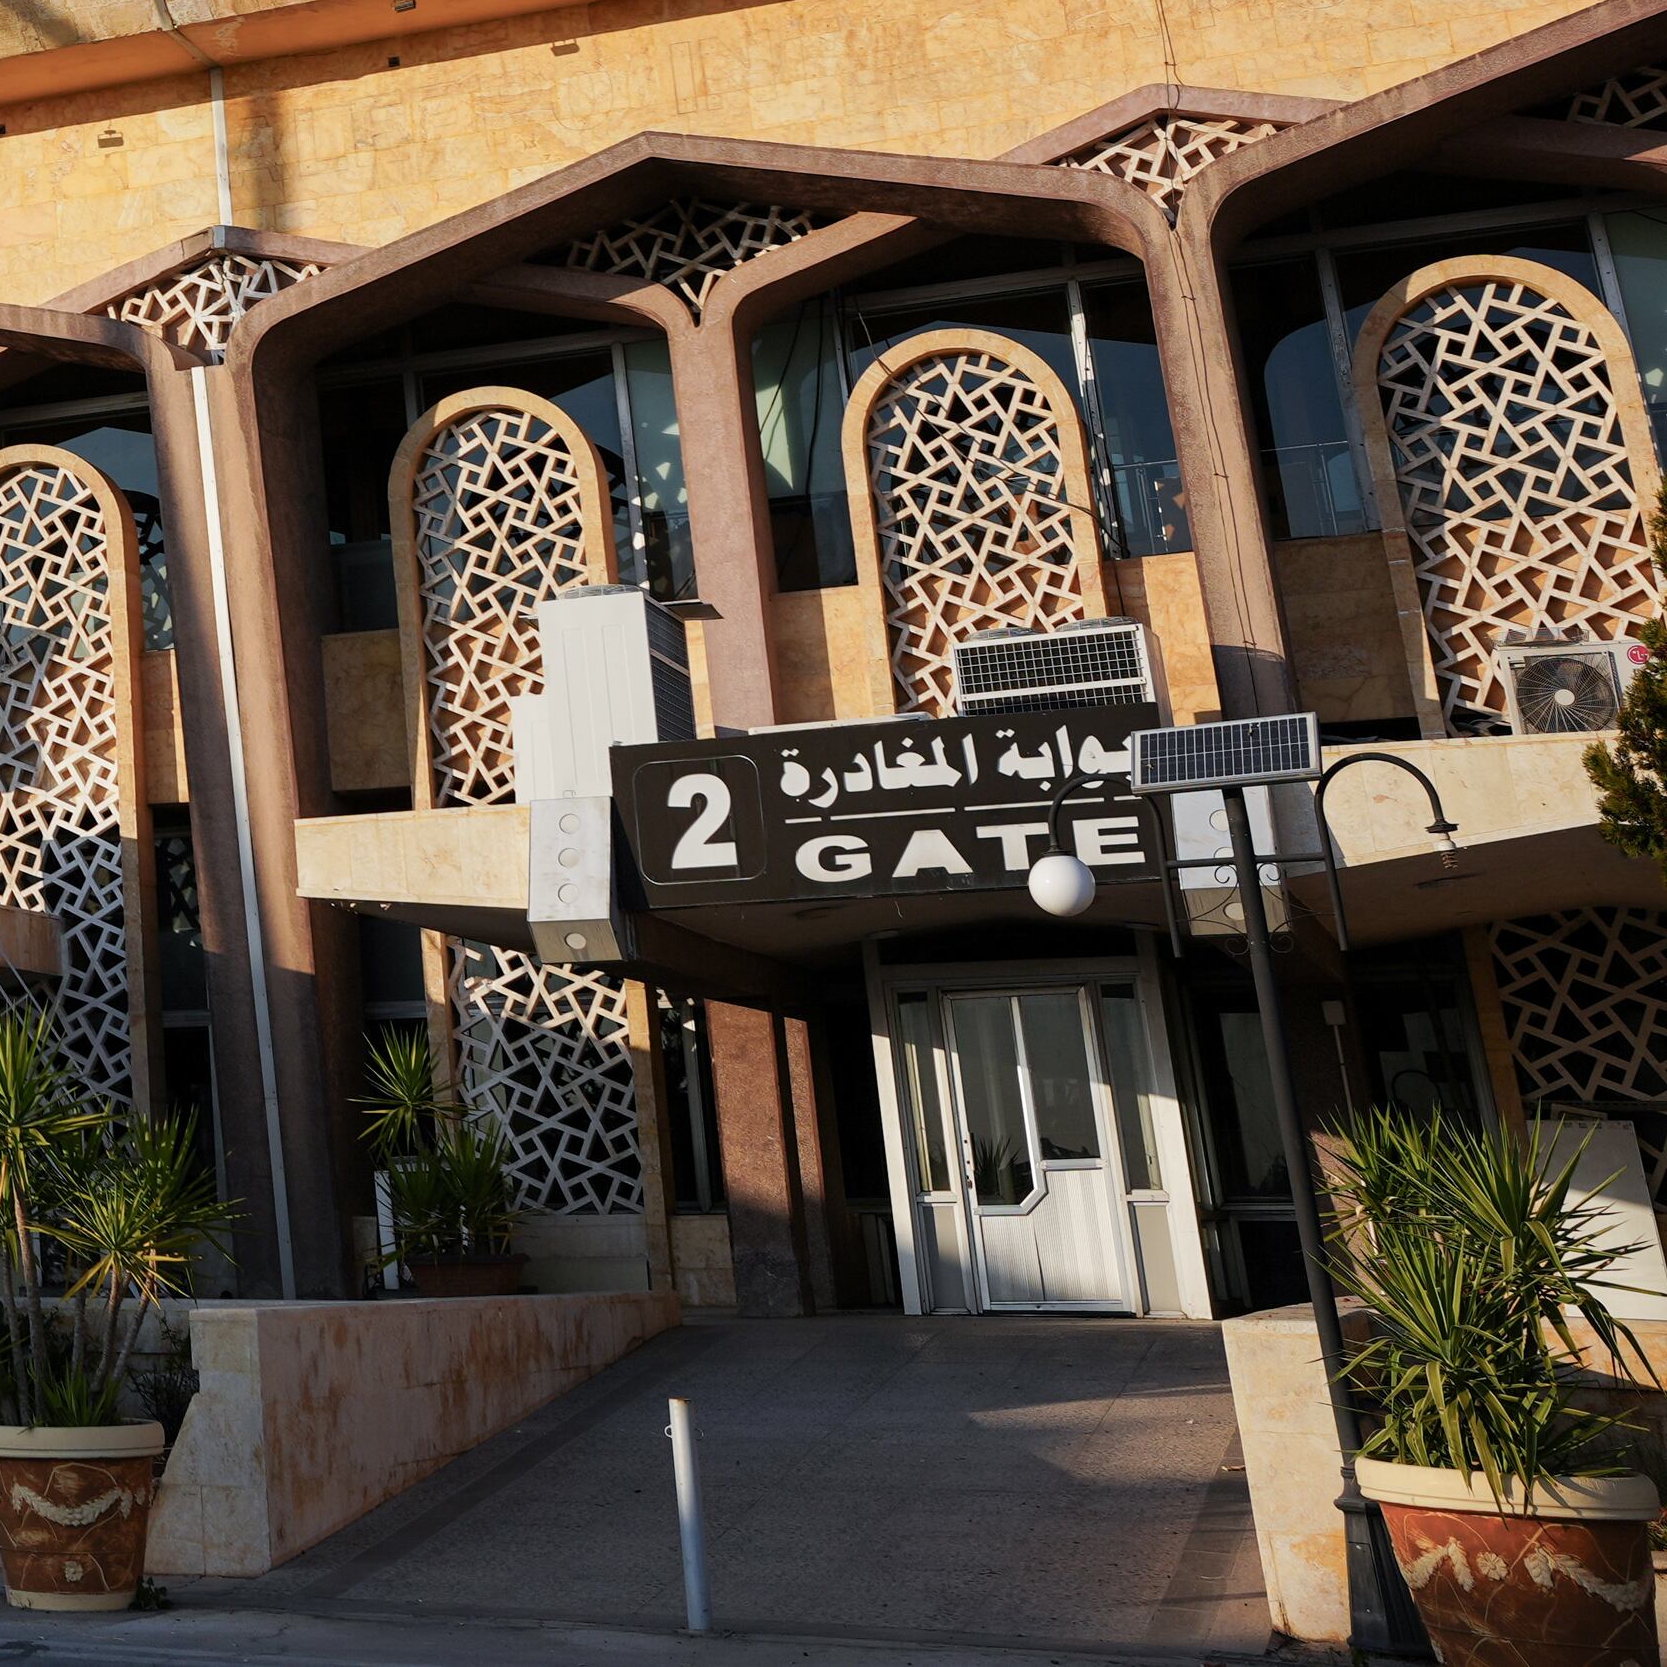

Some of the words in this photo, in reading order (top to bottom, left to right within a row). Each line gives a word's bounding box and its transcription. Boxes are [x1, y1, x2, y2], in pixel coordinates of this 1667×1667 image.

[780, 733, 978, 808] المغادرة
[668, 774, 739, 871] 2
[794, 814, 1146, 883] GATE
